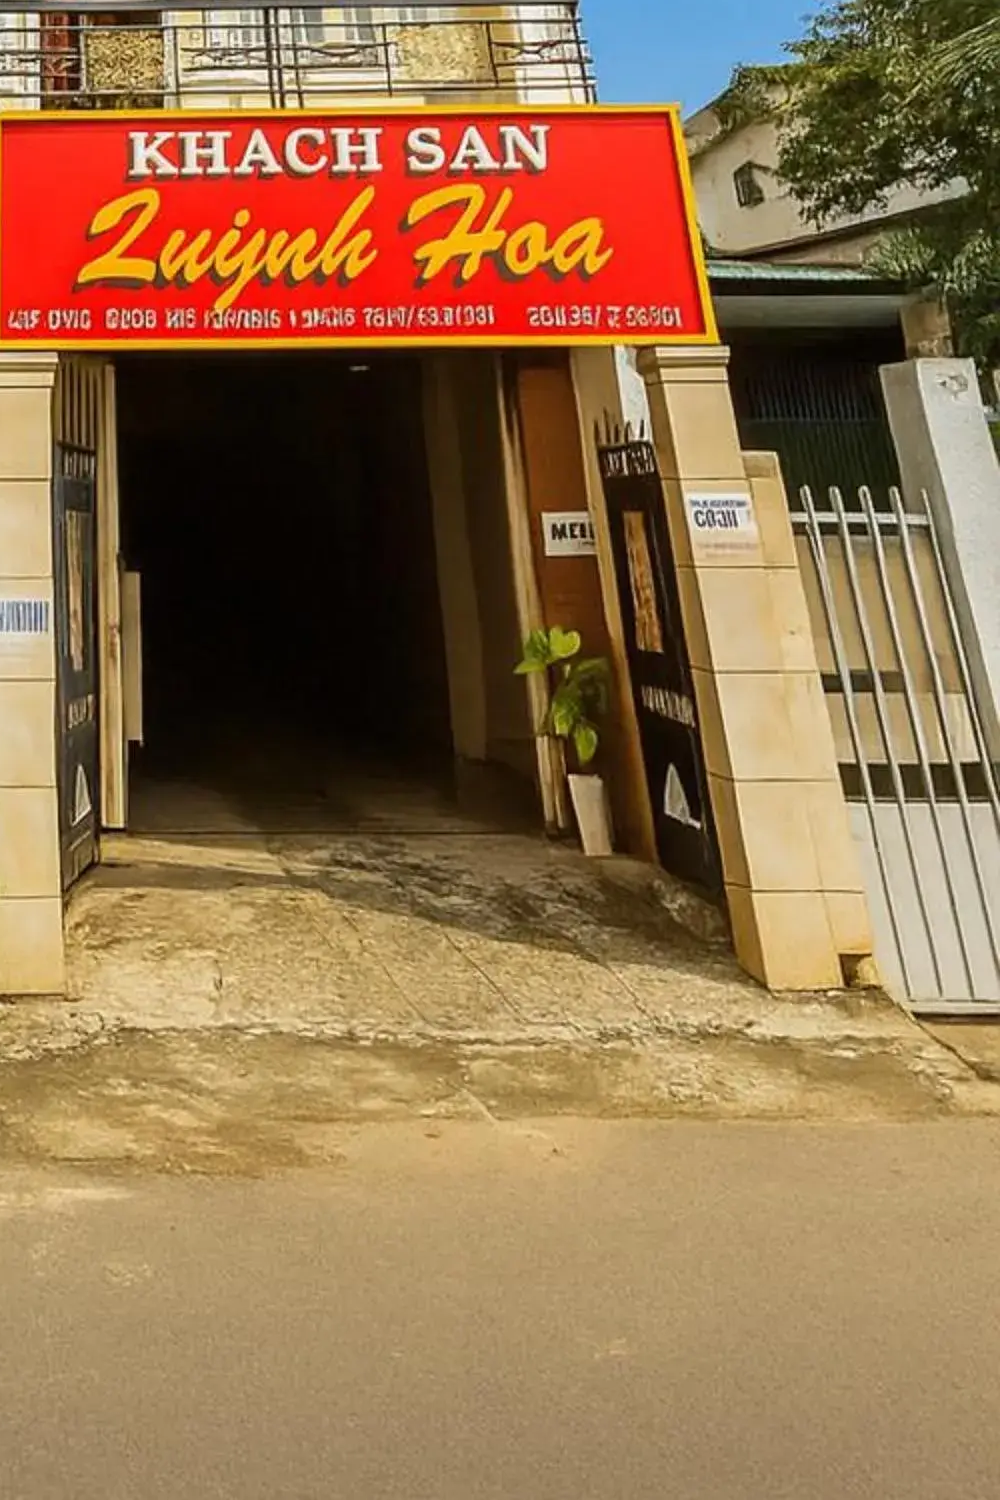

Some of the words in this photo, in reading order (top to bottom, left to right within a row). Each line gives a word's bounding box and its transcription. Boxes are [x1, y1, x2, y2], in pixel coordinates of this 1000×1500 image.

[127, 127, 383, 177] KHACH
[406, 124, 551, 173] SAN
[407, 182, 614, 281] Hoa
